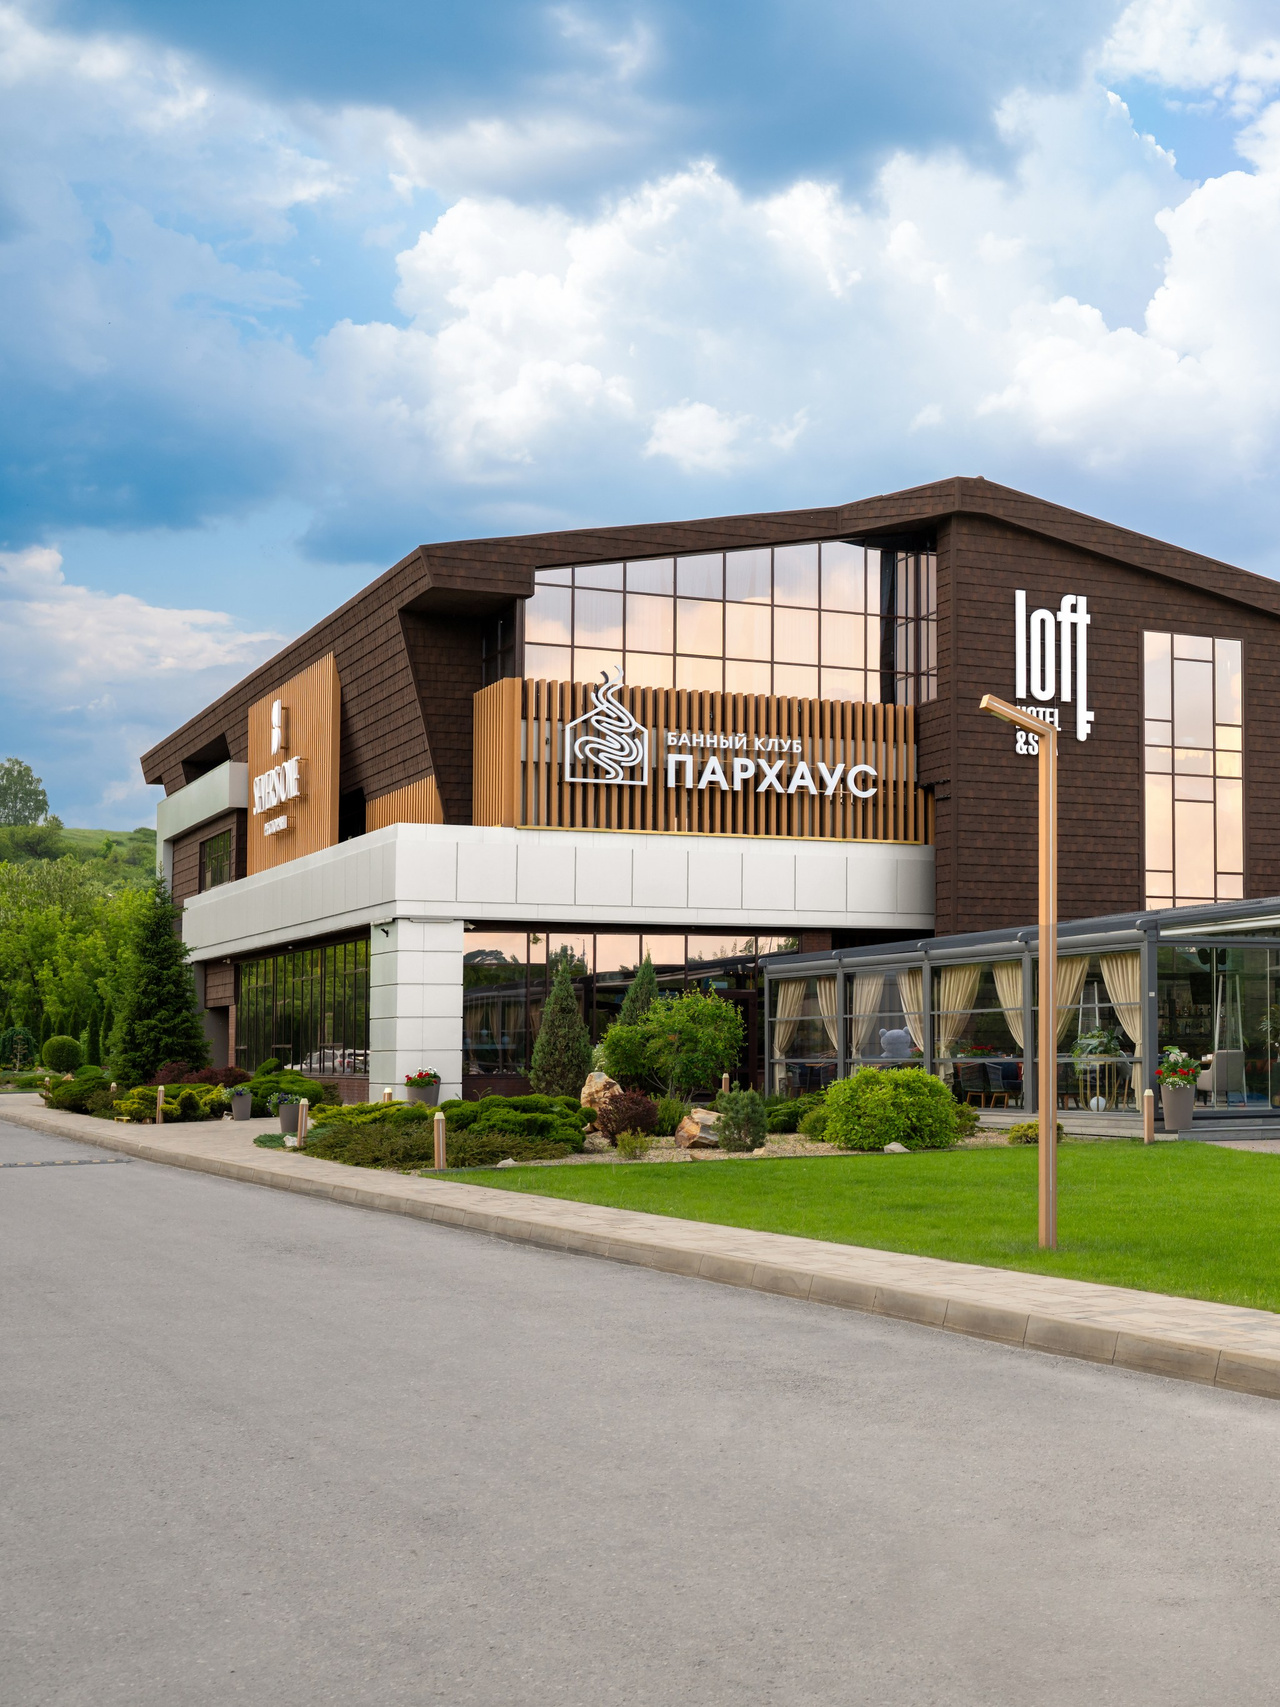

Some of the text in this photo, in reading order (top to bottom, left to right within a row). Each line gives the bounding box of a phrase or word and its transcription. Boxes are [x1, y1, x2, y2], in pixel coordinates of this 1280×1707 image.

[1015, 589, 1094, 742] loft
[667, 731, 802, 753] БАННЫЙ КЛУБ
[667, 753, 878, 798] ПАРХАУС
